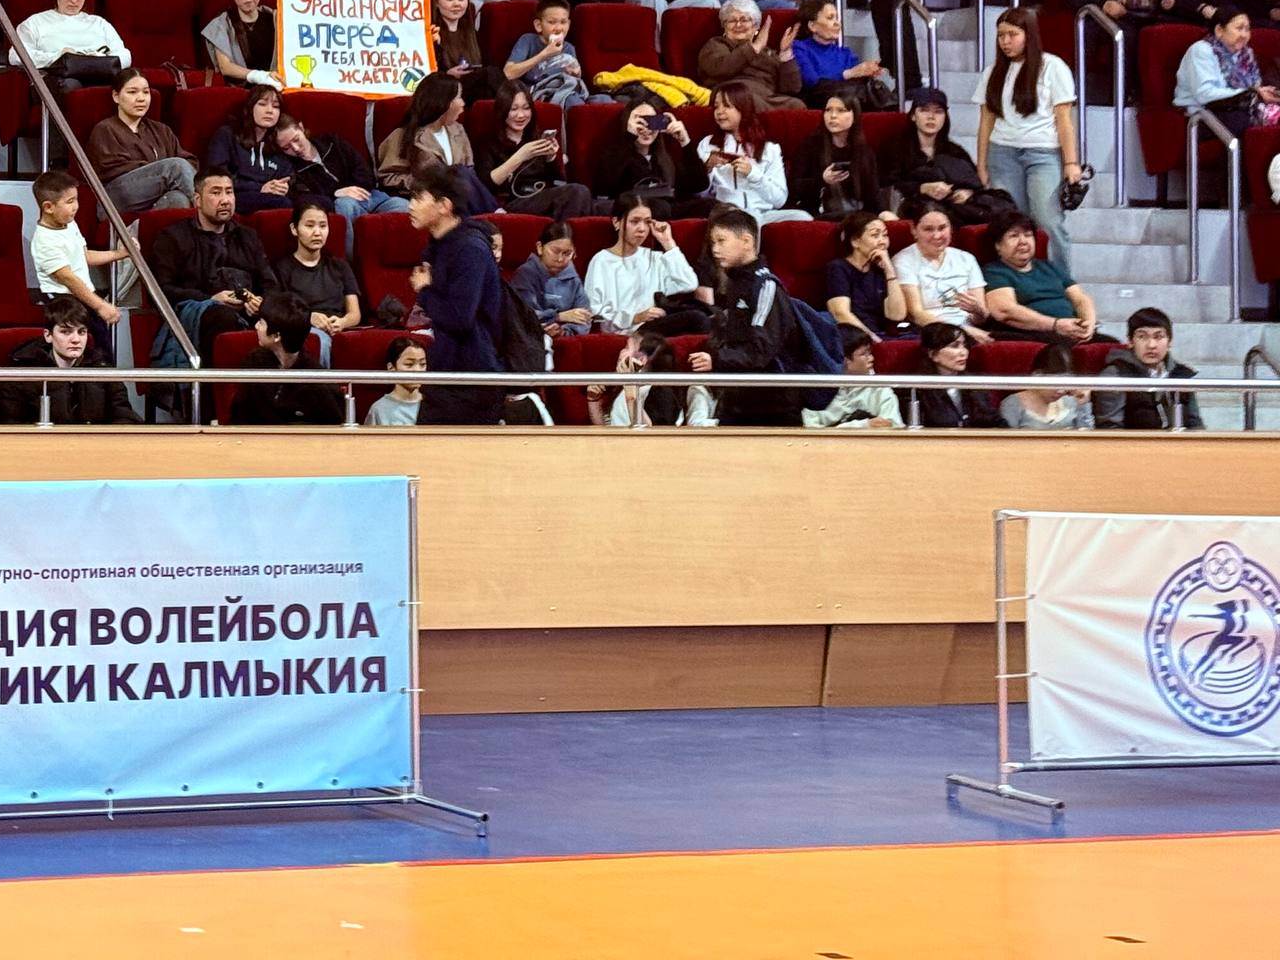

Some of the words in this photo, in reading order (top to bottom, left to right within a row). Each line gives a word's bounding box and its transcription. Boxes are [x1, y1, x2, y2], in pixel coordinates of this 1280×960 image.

[321, 50, 356, 66] ТЕБЯ
[360, 50, 424, 67] ПОБЕДА
[140, 563, 259, 581] общественная
[263, 562, 363, 578] организация
[90, 595, 380, 645] ВОЛЕЙБОЛА
[108, 656, 387, 701] КАЛМЫКИЯ
